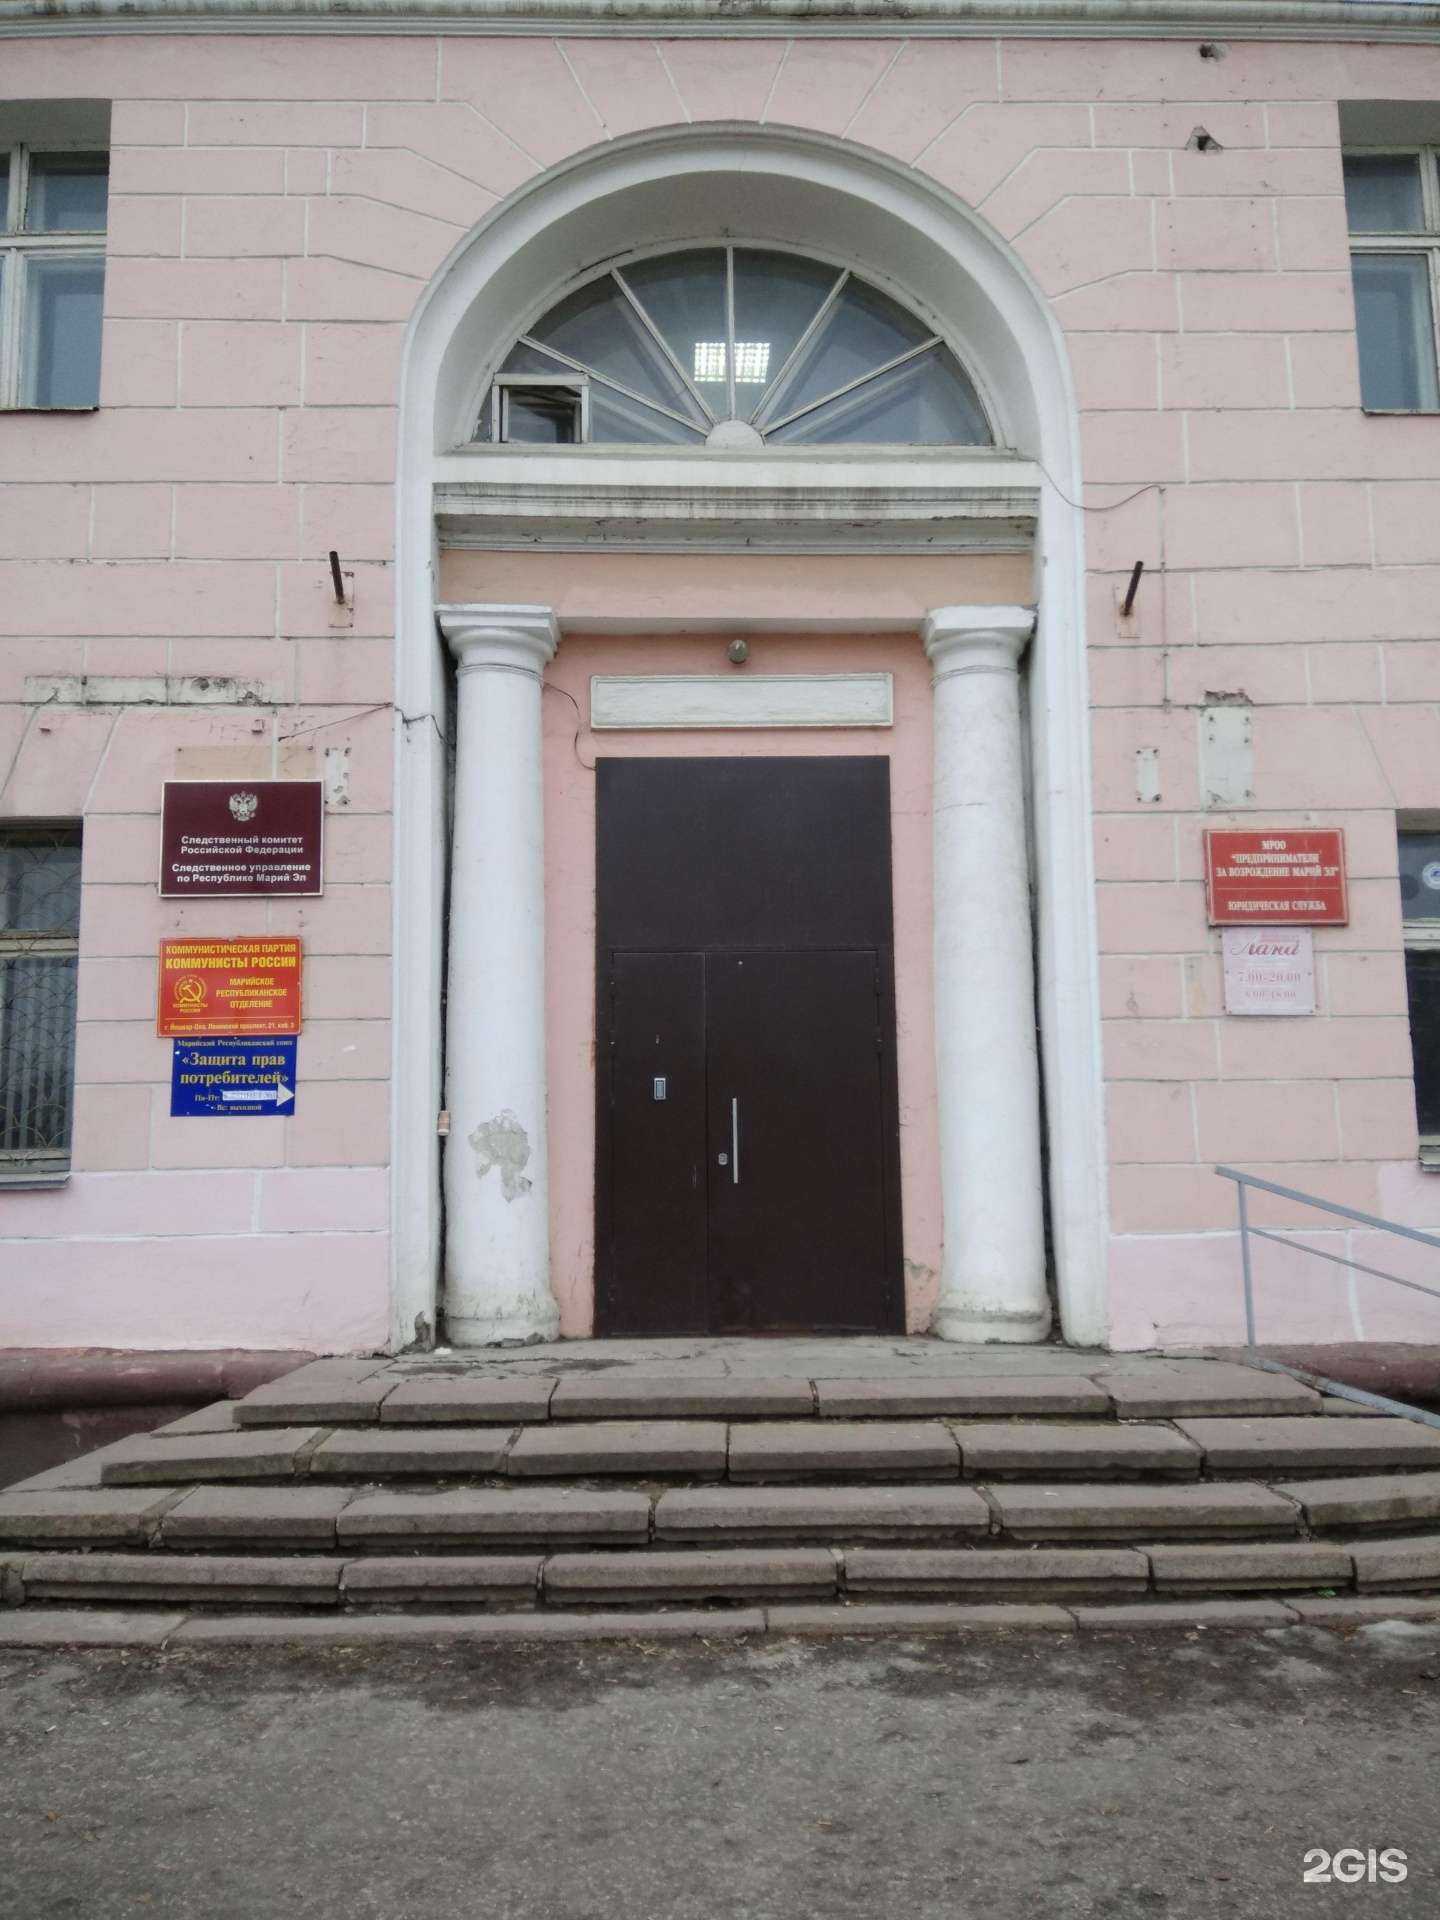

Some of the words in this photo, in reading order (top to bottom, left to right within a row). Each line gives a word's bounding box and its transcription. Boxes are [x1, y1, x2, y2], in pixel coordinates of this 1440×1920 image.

[181, 836, 259, 845] Следственный
[261, 837, 303, 845] комитет
[180, 845, 242, 855] Российской
[245, 845, 304, 856] Федерации
[171, 863, 247, 873] Следственное
[249, 864, 312, 874] управление
[1215, 867, 1227, 877] ЗА
[1228, 866, 1290, 878] ВОЗРОЖДЕНИЕ
[1293, 866, 1322, 877] МАРИЙ
[177, 875, 190, 883] по
[192, 873, 254, 884] Республике
[256, 873, 290, 884] Марий
[292, 873, 306, 882] Эл
[1227, 900, 1290, 911] ЮРИДИЧЕСКАЯ
[1291, 900, 1327, 911] СЛУЖБА
[166, 944, 261, 955] КОММУНИСТИЧЕСКАЯ
[262, 943, 296, 953] ПАРТИЯ
[165, 956, 248, 969] КОММУНИСТЫ
[251, 956, 296, 968] РОССИИ
[229, 977, 275, 986] МАРИЙСКОЕ
[215, 988, 288, 998] РЕСПУБЛИКАНСКОЕ
[229, 999, 273, 1009] ОТДЕЛЕНИЕ
[182, 1051, 247, 1067] «Защита
[252, 1055, 286, 1068] прав
[180, 1069, 289, 1087] потребителей»
